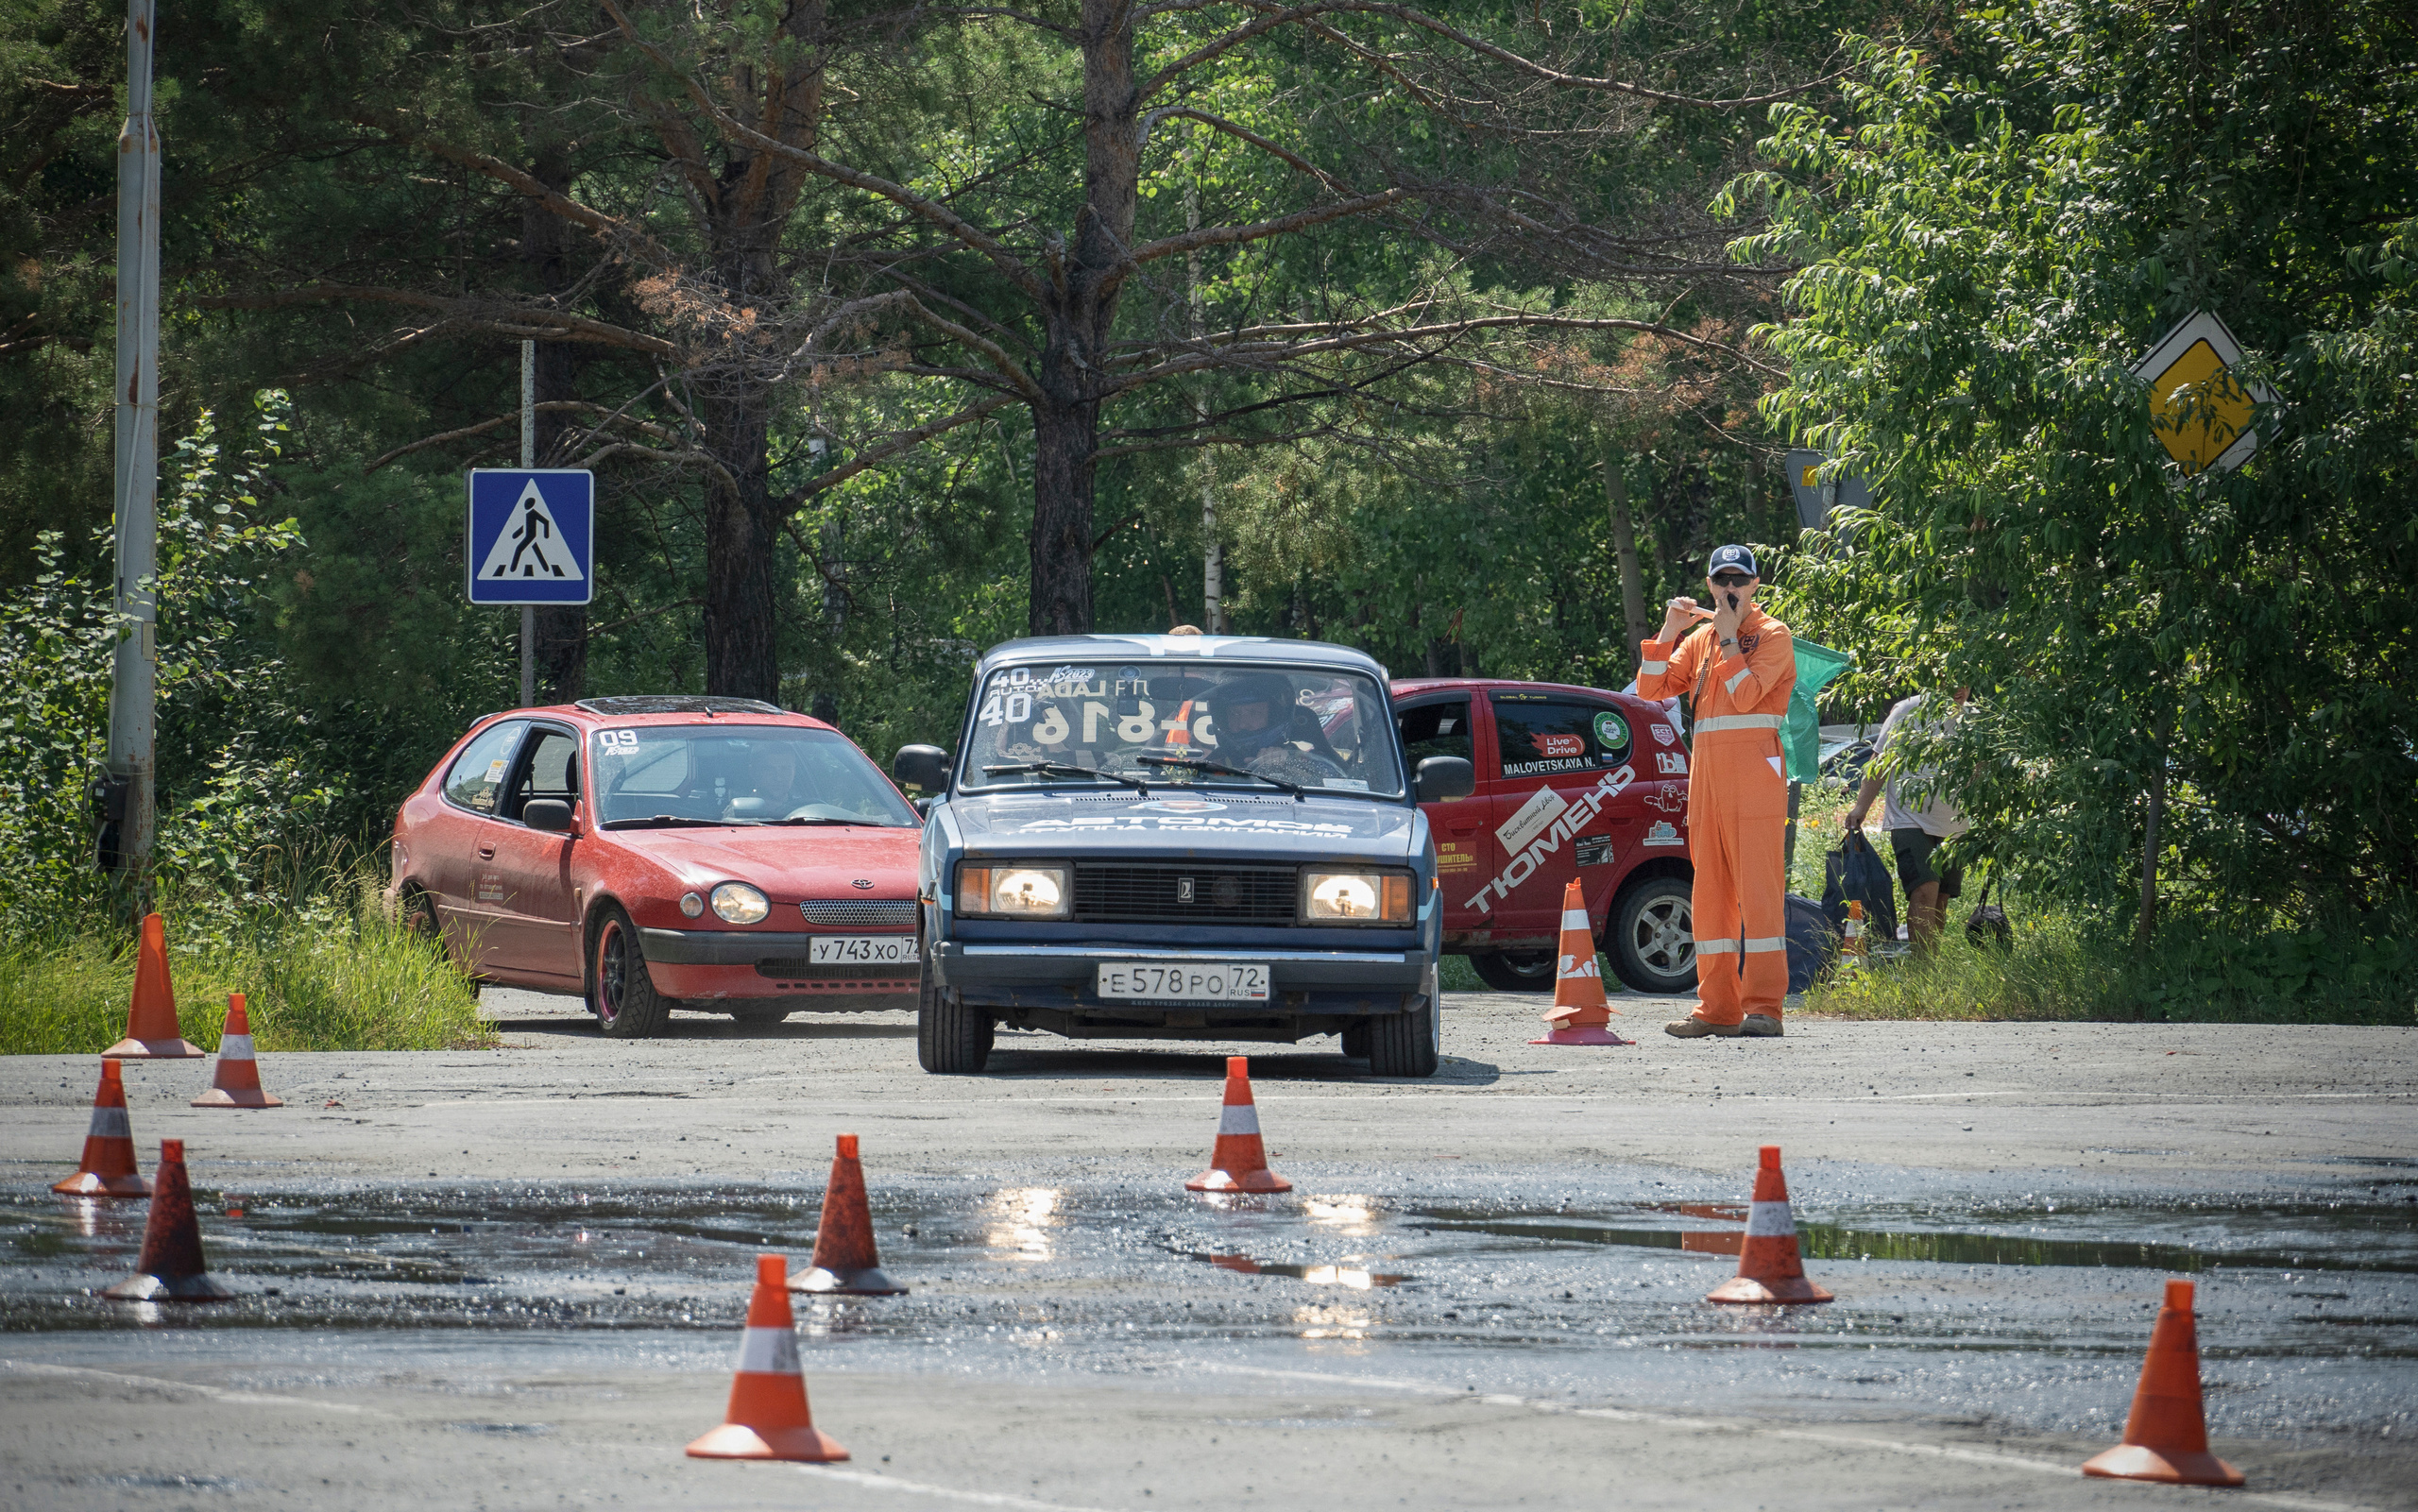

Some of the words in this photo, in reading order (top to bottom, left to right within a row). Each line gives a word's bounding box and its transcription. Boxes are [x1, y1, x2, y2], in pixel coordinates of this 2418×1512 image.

[990, 667, 1030, 688] 40
[979, 692, 1032, 727] 40
[598, 730, 639, 747] 09
[1546, 738, 1571, 746] Live
[1504, 757, 1584, 775] MALOVETSKAYA
[1584, 756, 1596, 768] N.
[1503, 806, 1541, 841] Бисквитный
[1541, 793, 1556, 810] Двор
[1018, 824, 1148, 834] ГРУППА
[1158, 824, 1349, 840] КОМПАНИЙ
[1464, 764, 1636, 914] ТЮМЕНЬ
[1441, 842, 1456, 852] СТО
[819, 940, 899, 960] У743ХО
[1111, 968, 1223, 994] Е578РО
[1233, 968, 1258, 988] 72
[1230, 988, 1251, 997] RUS
